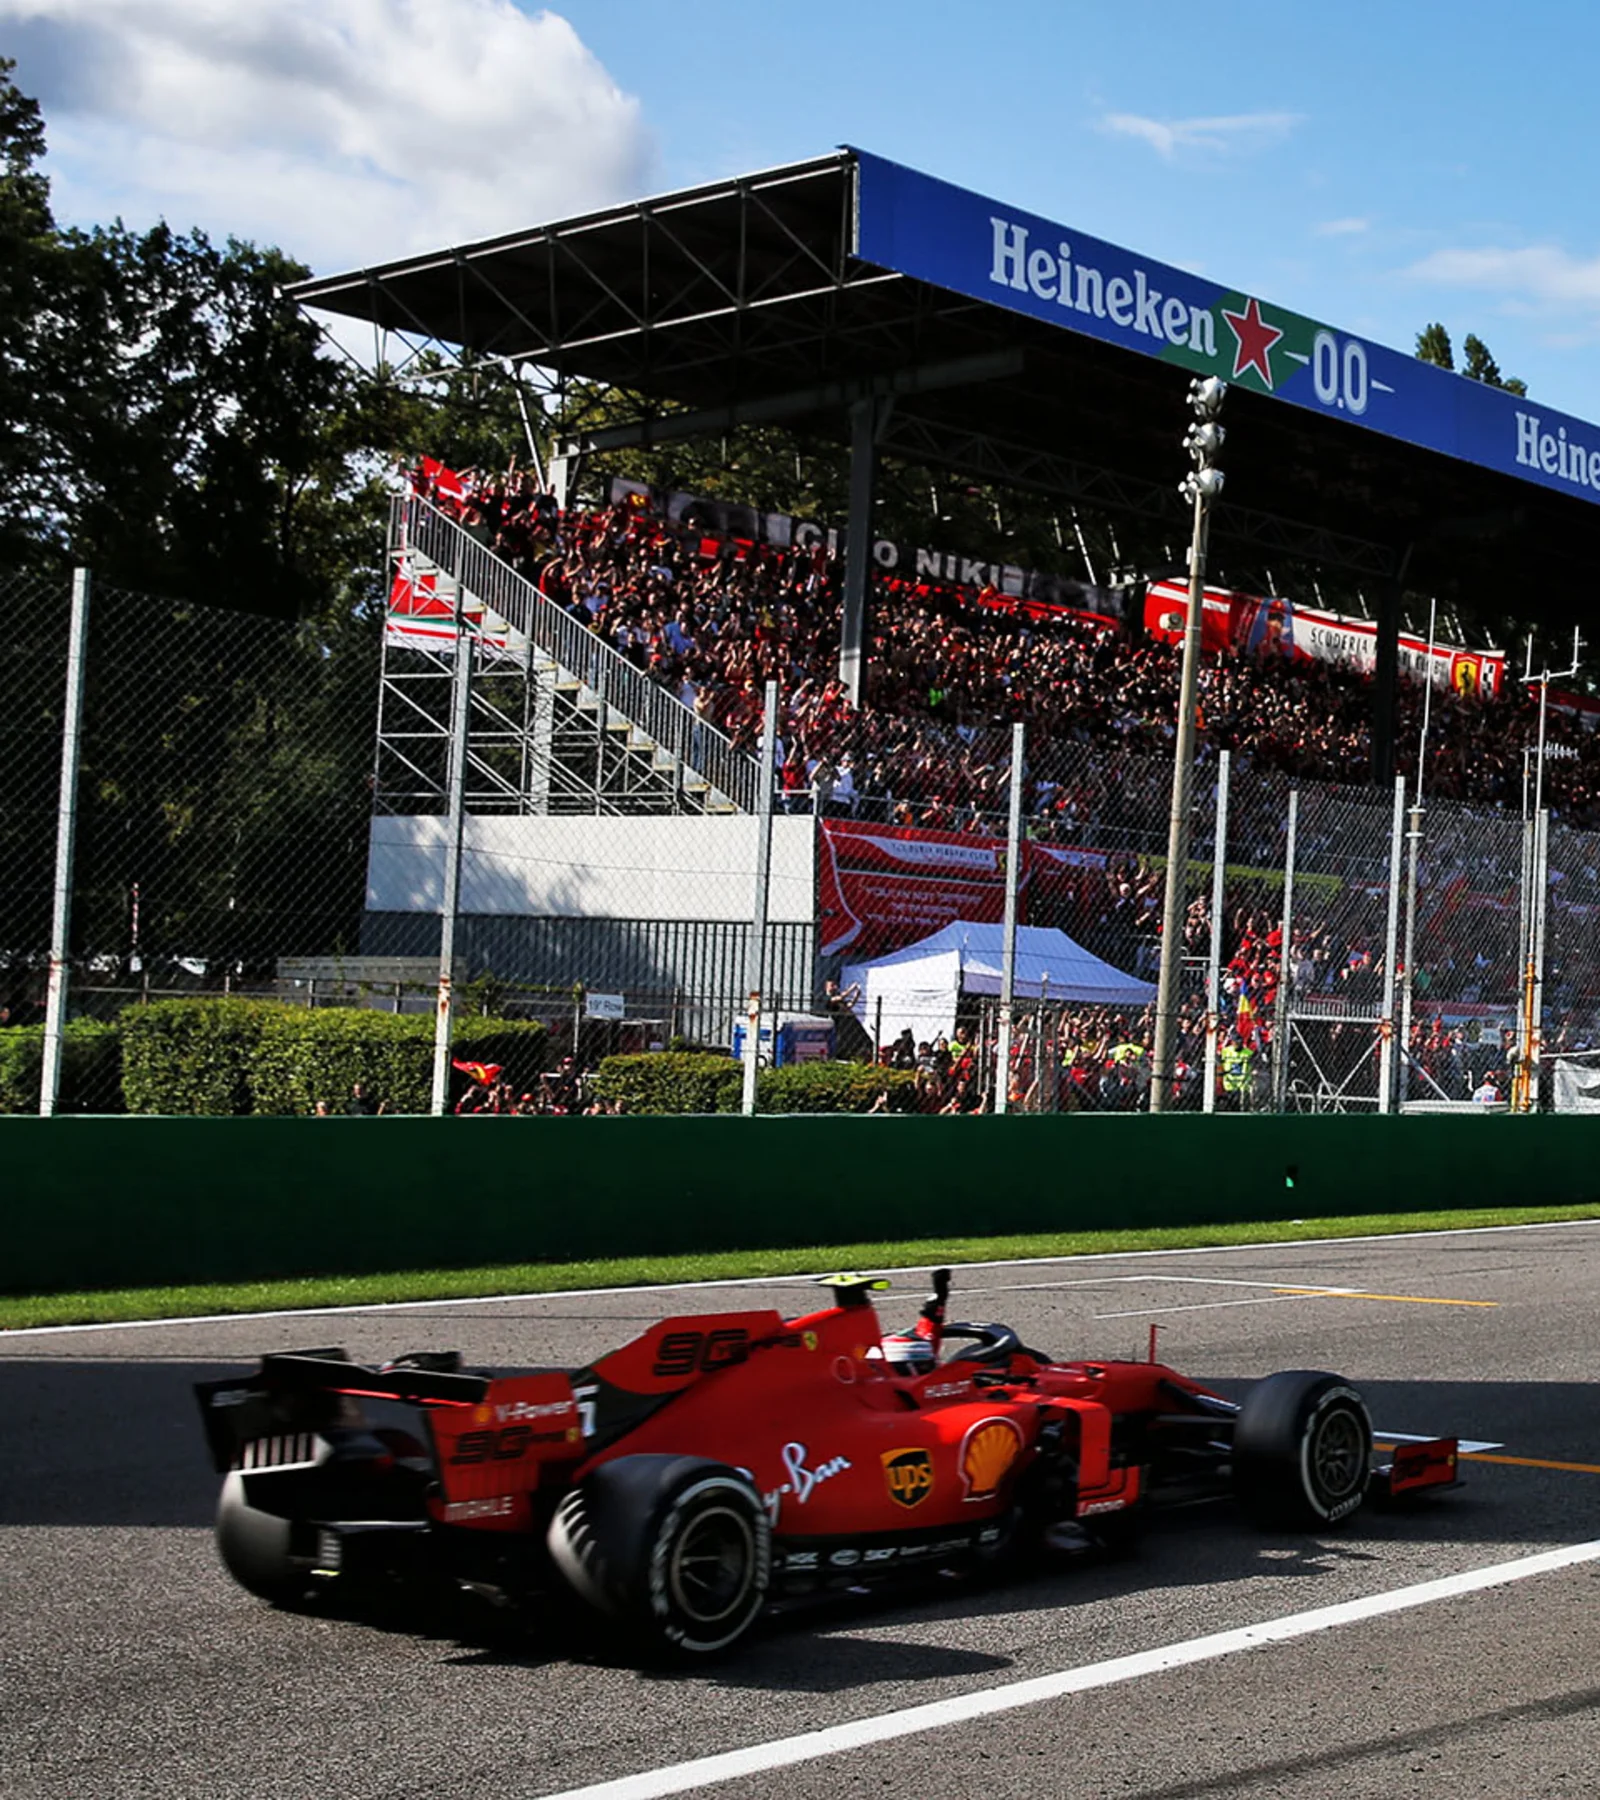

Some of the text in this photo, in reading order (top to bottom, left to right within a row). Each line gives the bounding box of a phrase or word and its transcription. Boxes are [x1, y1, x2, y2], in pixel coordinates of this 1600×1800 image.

[990, 217, 1367, 415] Heineken 0.0
[1310, 627, 1368, 654] SCUDERIA
[886, 1463, 933, 1499] ups
[444, 1496, 513, 1522] MAHLE
